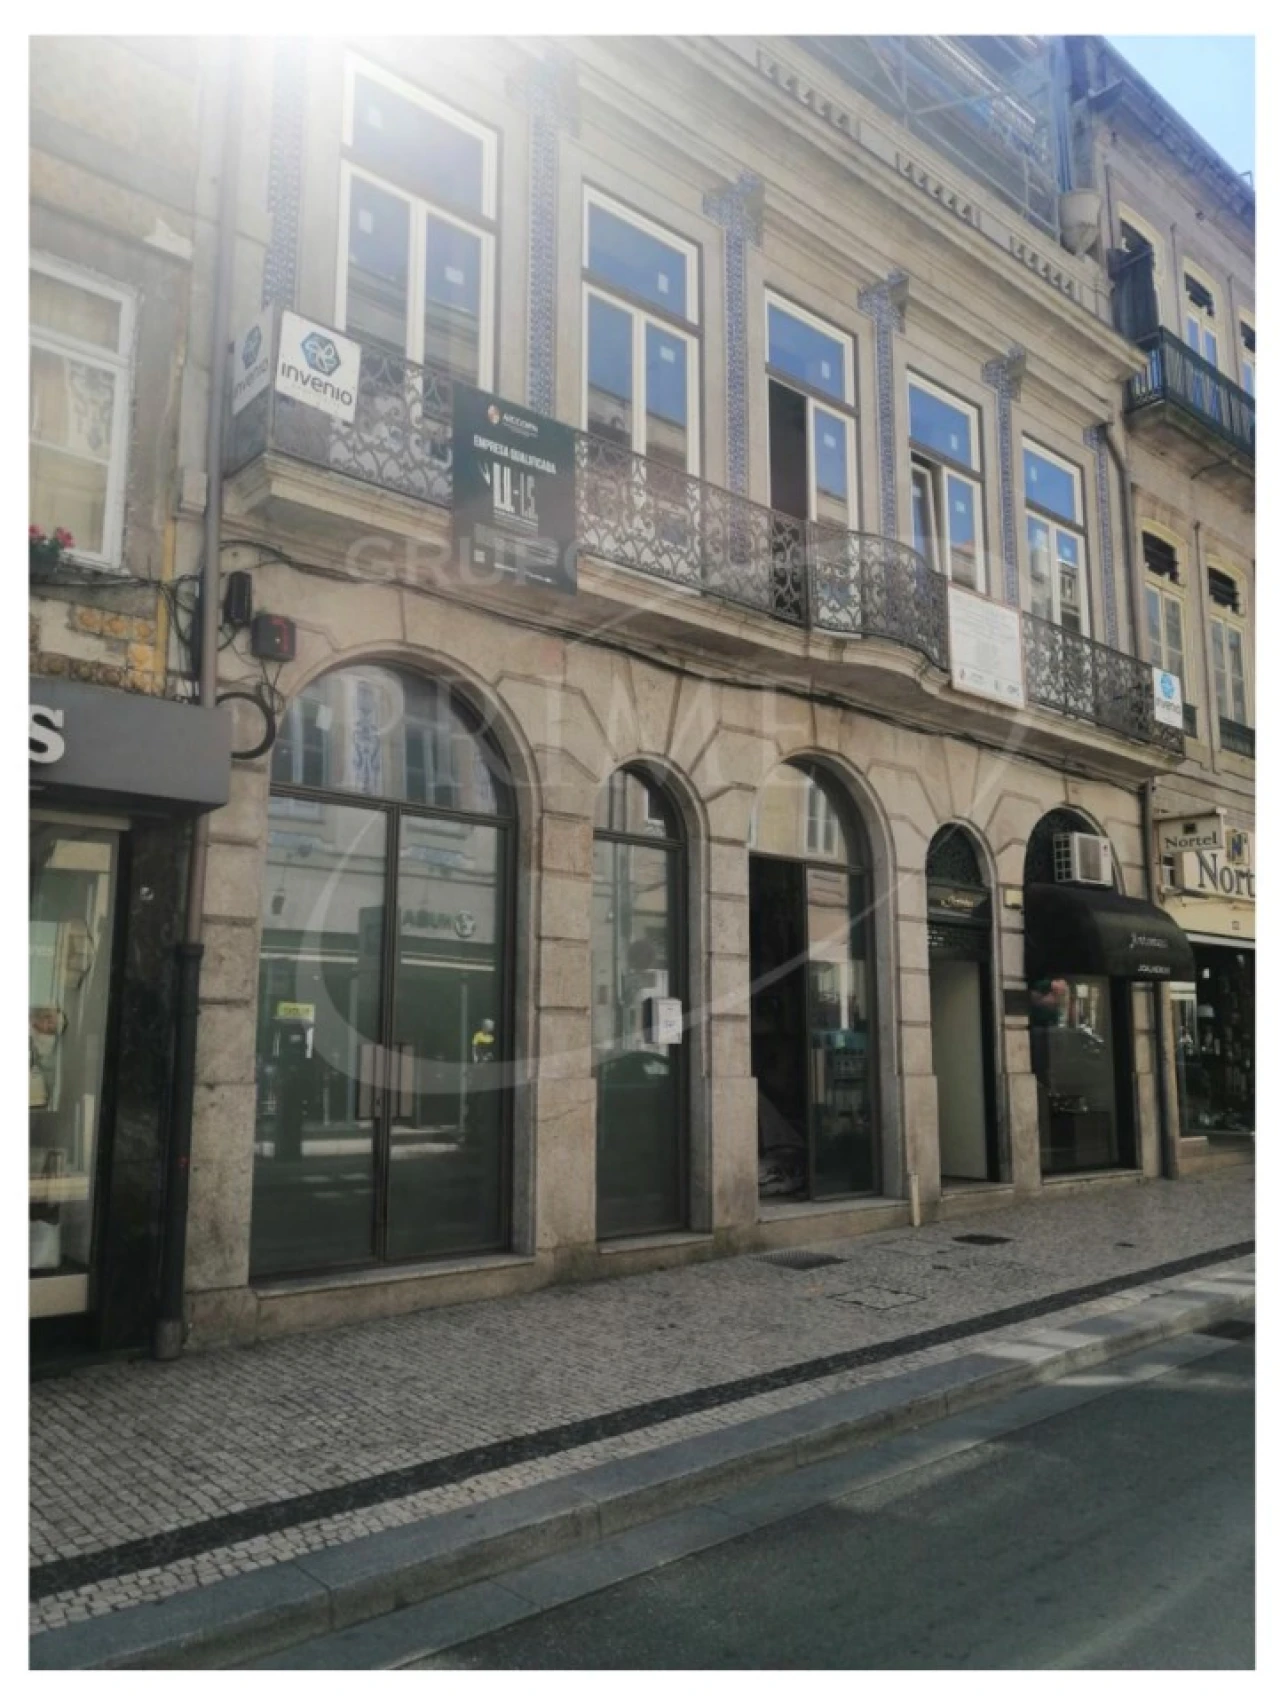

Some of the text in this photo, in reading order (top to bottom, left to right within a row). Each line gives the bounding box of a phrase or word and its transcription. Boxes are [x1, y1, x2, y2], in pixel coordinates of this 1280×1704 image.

[280, 361, 353, 406] invenio
[473, 434, 509, 457] EMPRESA
[1164, 830, 1217, 849] Nortel
